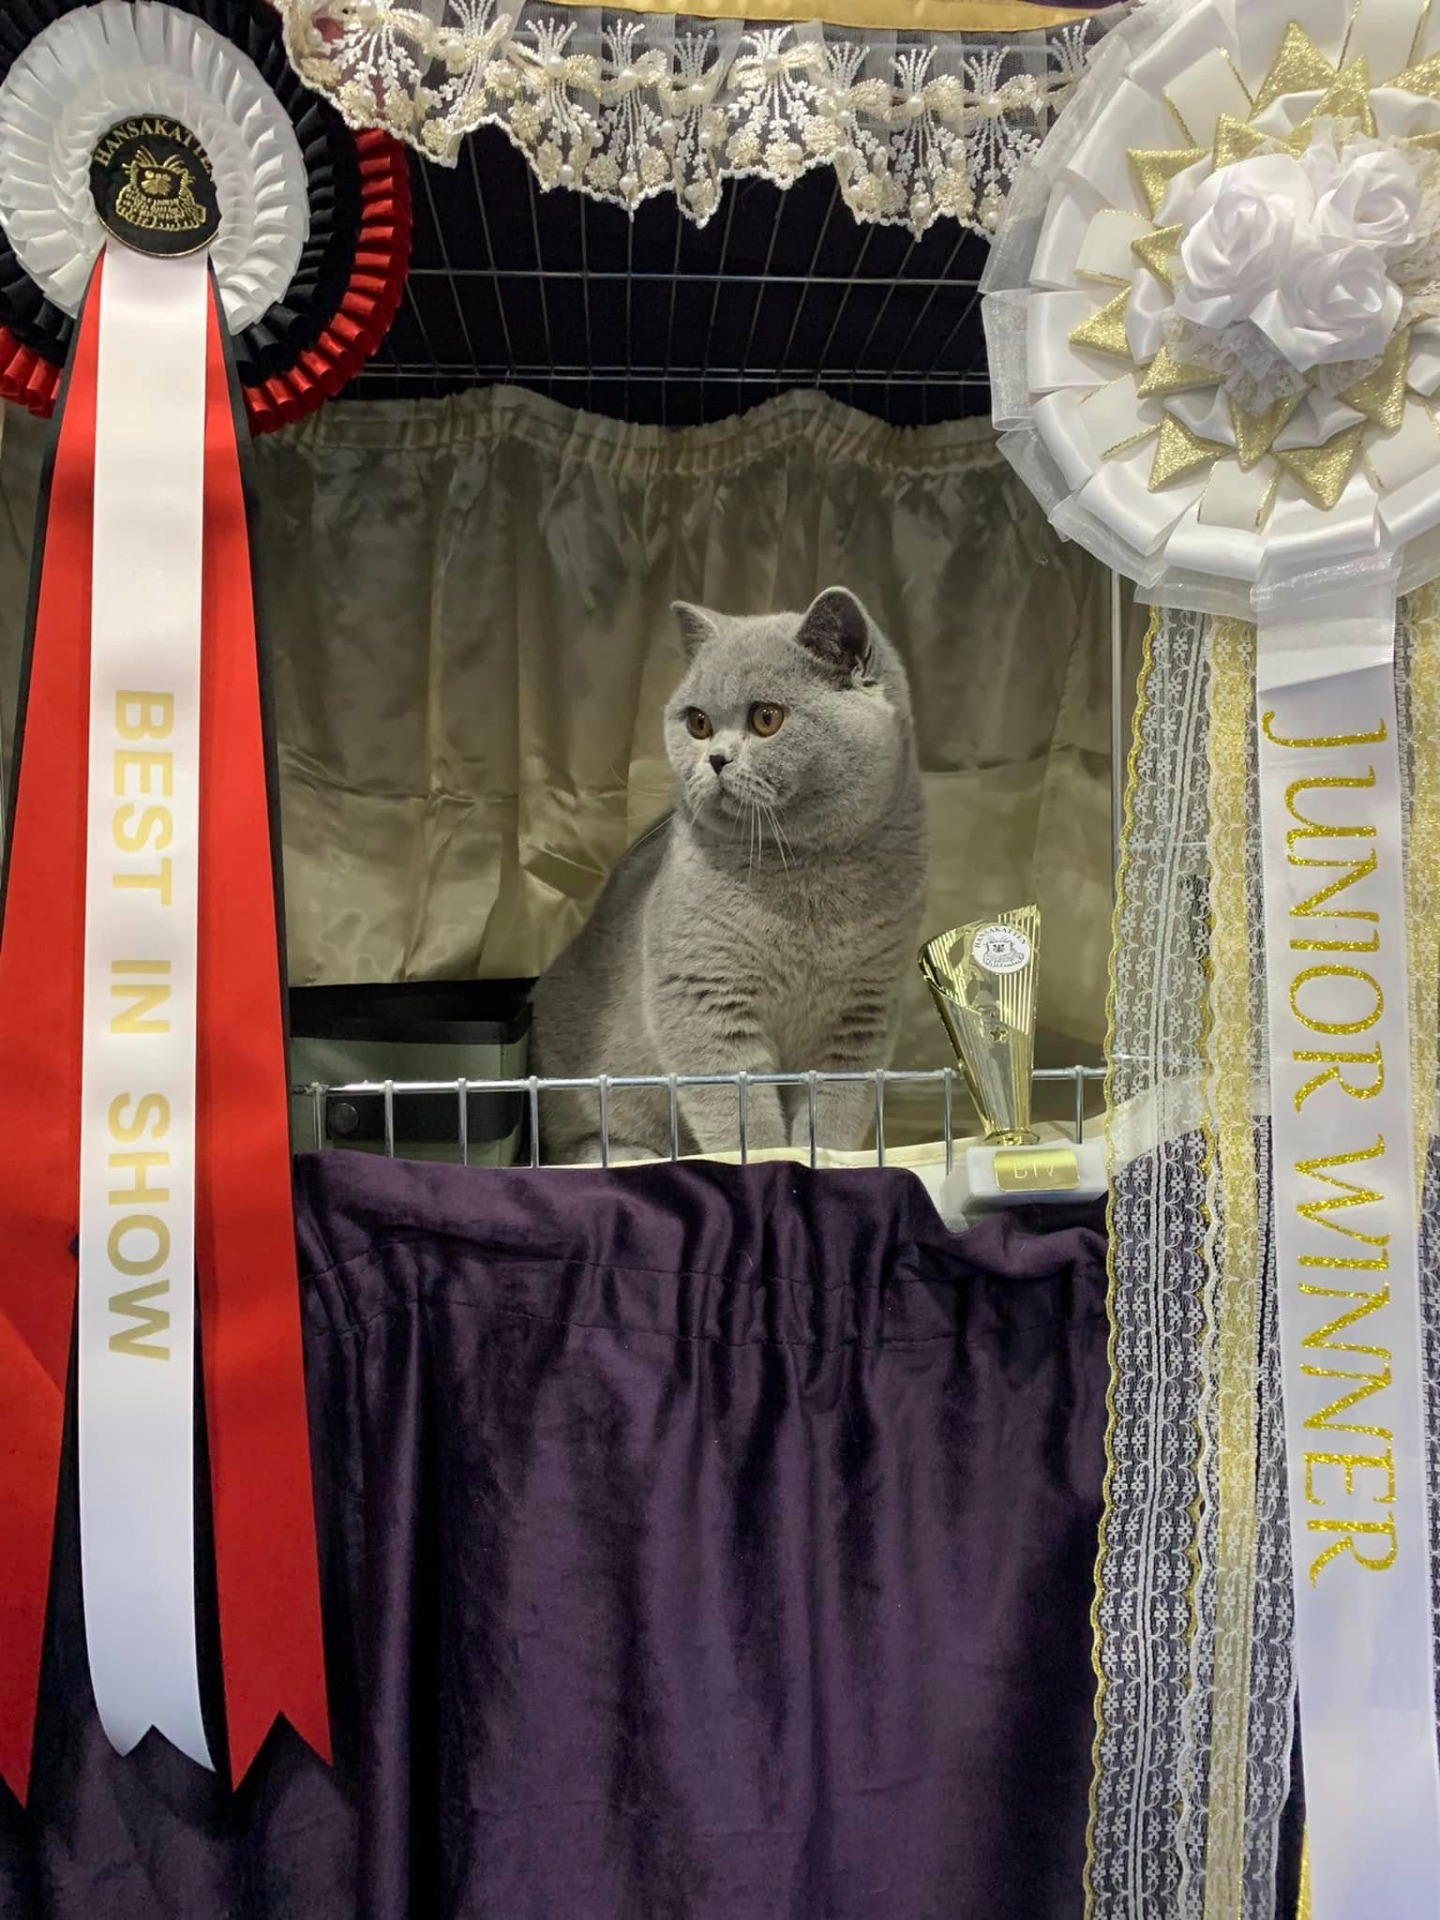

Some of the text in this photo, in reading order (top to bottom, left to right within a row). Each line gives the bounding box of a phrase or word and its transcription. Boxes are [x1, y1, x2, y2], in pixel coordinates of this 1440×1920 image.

[107, 690, 175, 1361] BEST IN SHOW
[1262, 711, 1398, 1589] JUNIOR WINNER
